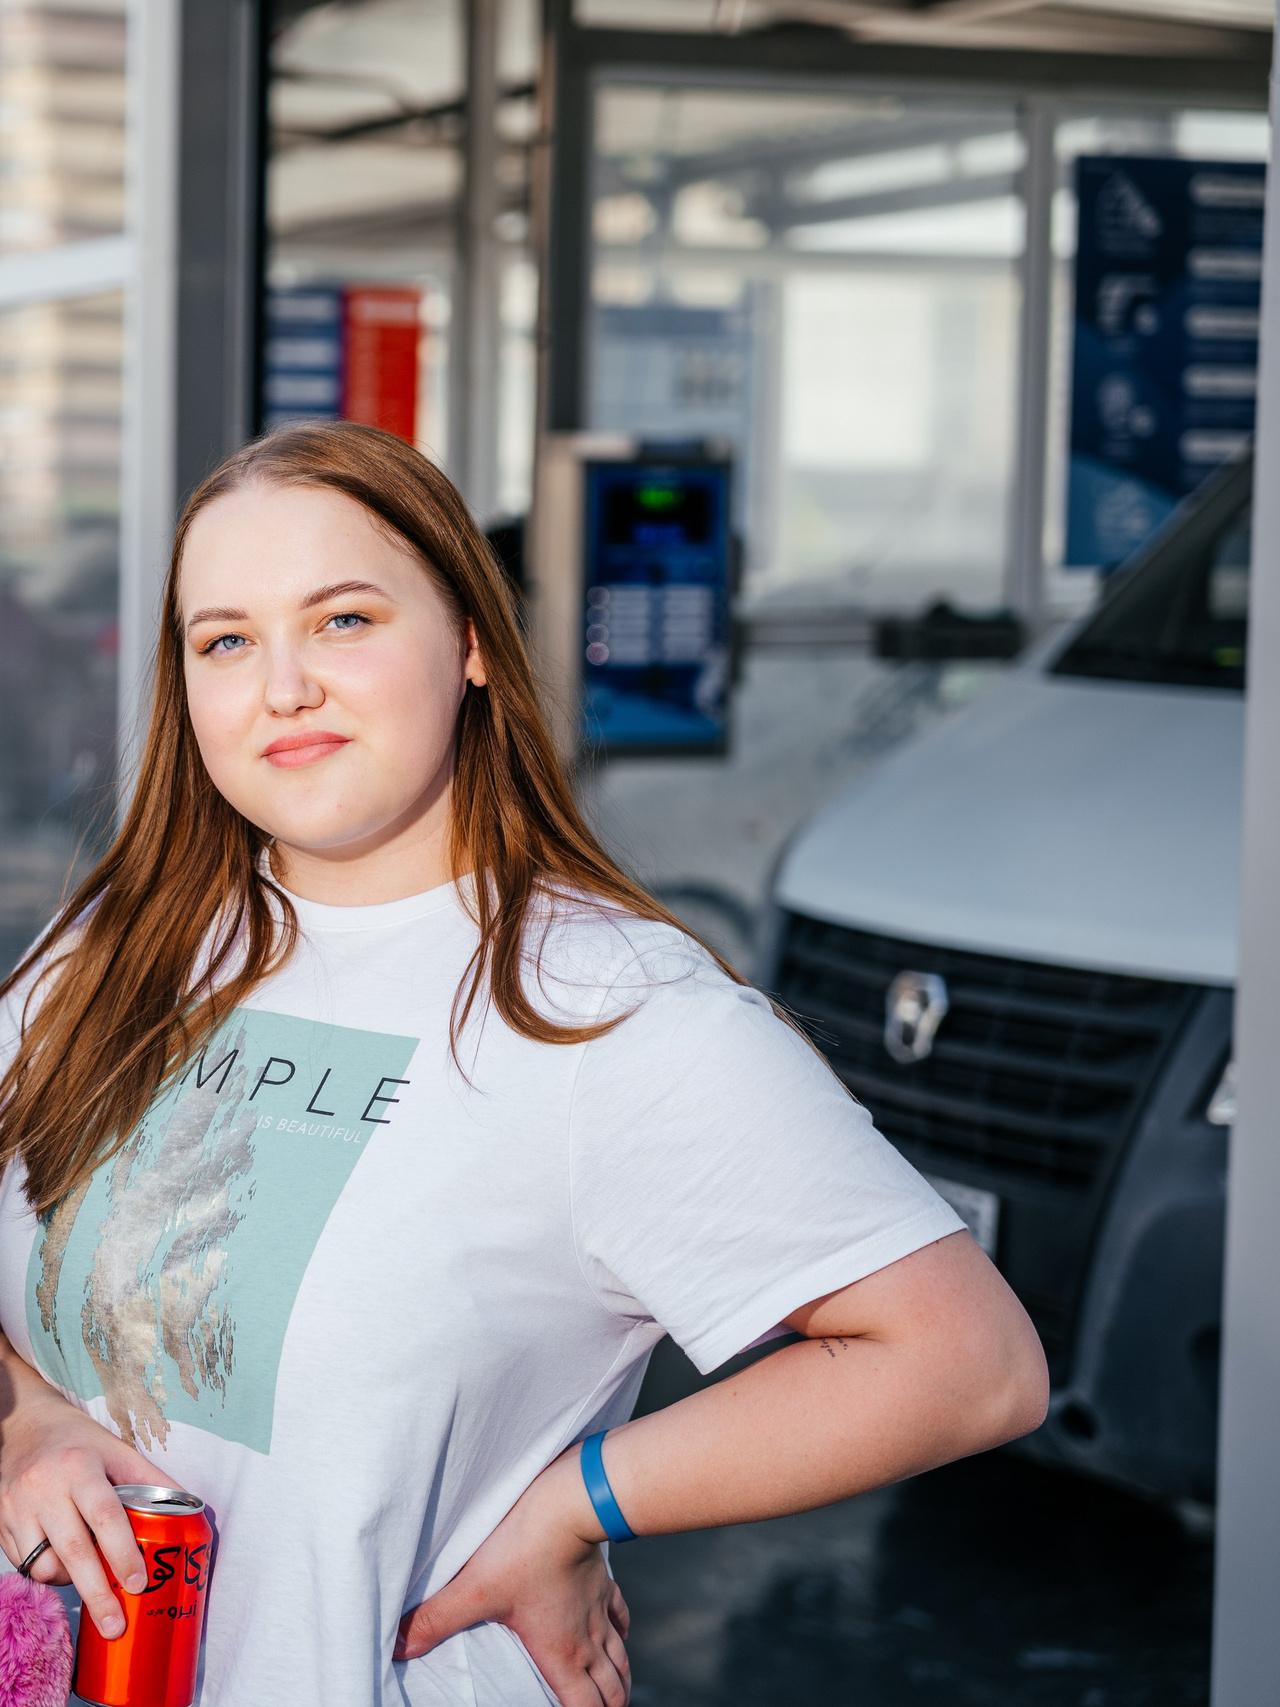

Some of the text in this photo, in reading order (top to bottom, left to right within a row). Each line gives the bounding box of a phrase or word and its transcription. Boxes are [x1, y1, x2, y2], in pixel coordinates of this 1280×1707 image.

[180, 1045, 411, 1125] MPLE
[255, 1115, 362, 1143] IS BEAUTIFUL
